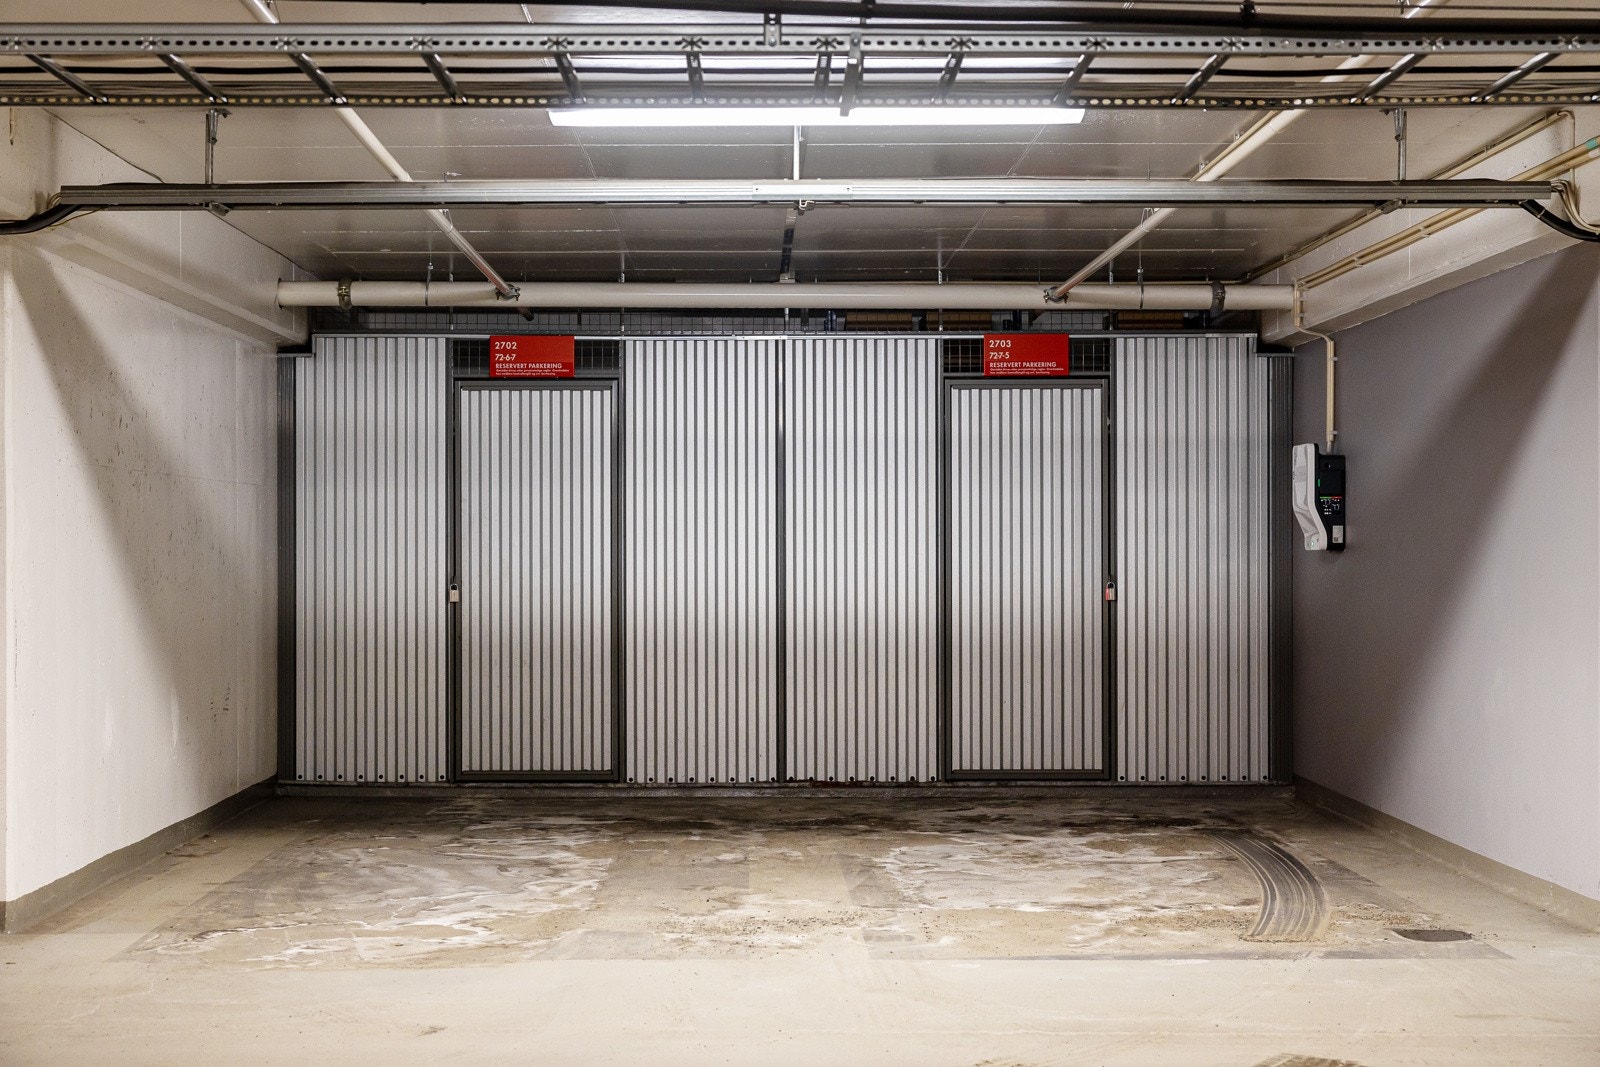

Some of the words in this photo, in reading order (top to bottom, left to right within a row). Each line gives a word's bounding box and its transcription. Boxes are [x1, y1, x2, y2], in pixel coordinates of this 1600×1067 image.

[494, 341, 517, 350] 2702
[989, 340, 1012, 348] 2703
[494, 353, 516, 361] 72-6-7
